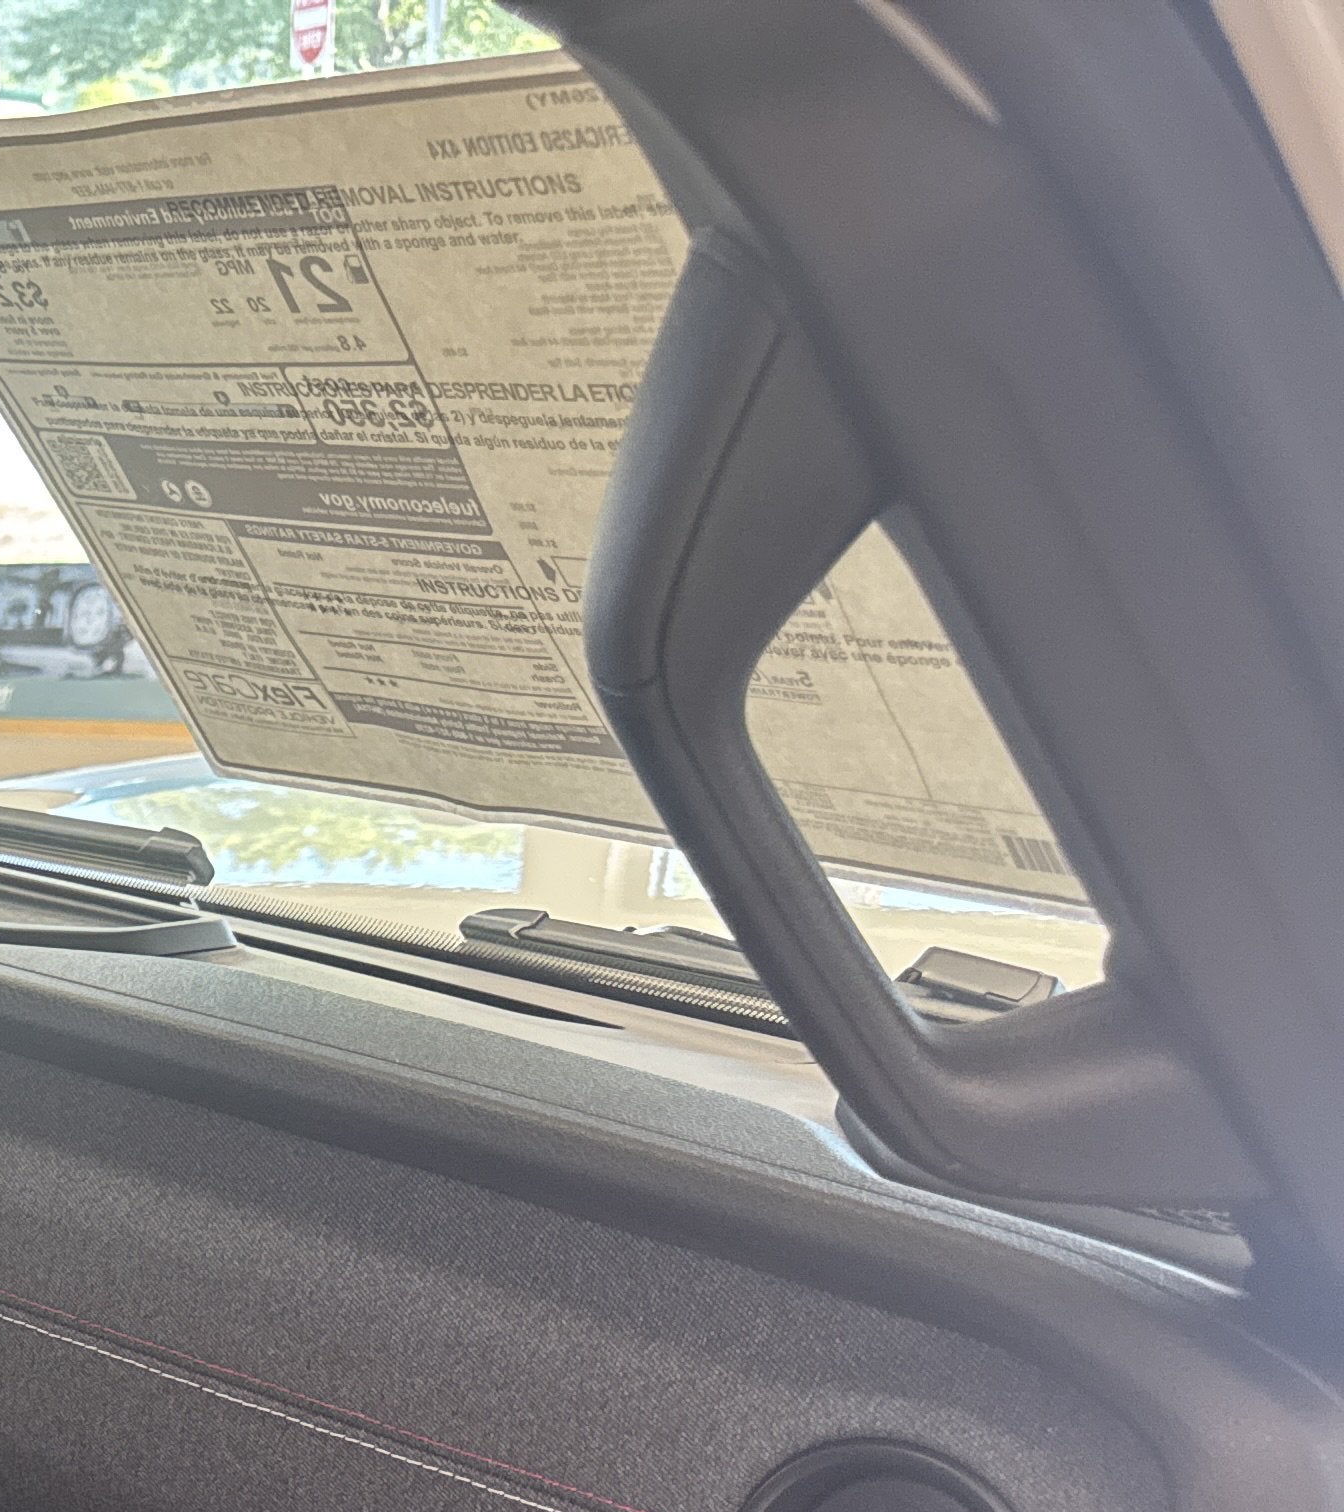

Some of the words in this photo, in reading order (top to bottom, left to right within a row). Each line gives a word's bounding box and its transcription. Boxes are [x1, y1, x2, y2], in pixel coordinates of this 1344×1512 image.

[413, 170, 583, 204] INSTRUCTIONS
[351, 219, 390, 234] other
[389, 217, 432, 234] sharp
[431, 214, 482, 232] object.
[483, 212, 504, 226] To
[505, 210, 564, 225] remove
[563, 207, 596, 222] this
[112, 248, 160, 264] remains
[157, 248, 177, 261] on
[175, 247, 198, 260] the
[195, 245, 237, 262] glass,
[232, 244, 246, 257] it
[381, 239, 393, 250] a
[392, 233, 448, 252] sponge
[445, 232, 477, 247] and
[477, 230, 525, 246] water.
[425, 382, 559, 401] DESPRENDER
[556, 383, 589, 401] LA
[449, 409, 467, 424] 2)
[465, 412, 478, 424] y
[476, 411, 559, 428] despeguela
[317, 428, 356, 440] dañar
[354, 430, 369, 441] el
[412, 431, 429, 443] Si
[470, 433, 511, 450] algún
[510, 437, 567, 449] residuo
[567, 438, 588, 450] de
[588, 438, 606, 450] la
[415, 577, 563, 604] INSTRUCTIONS
[527, 609, 555, 622] pas
[843, 634, 882, 648] Pour
[851, 653, 883, 664] une
[885, 654, 952, 669] éponge
